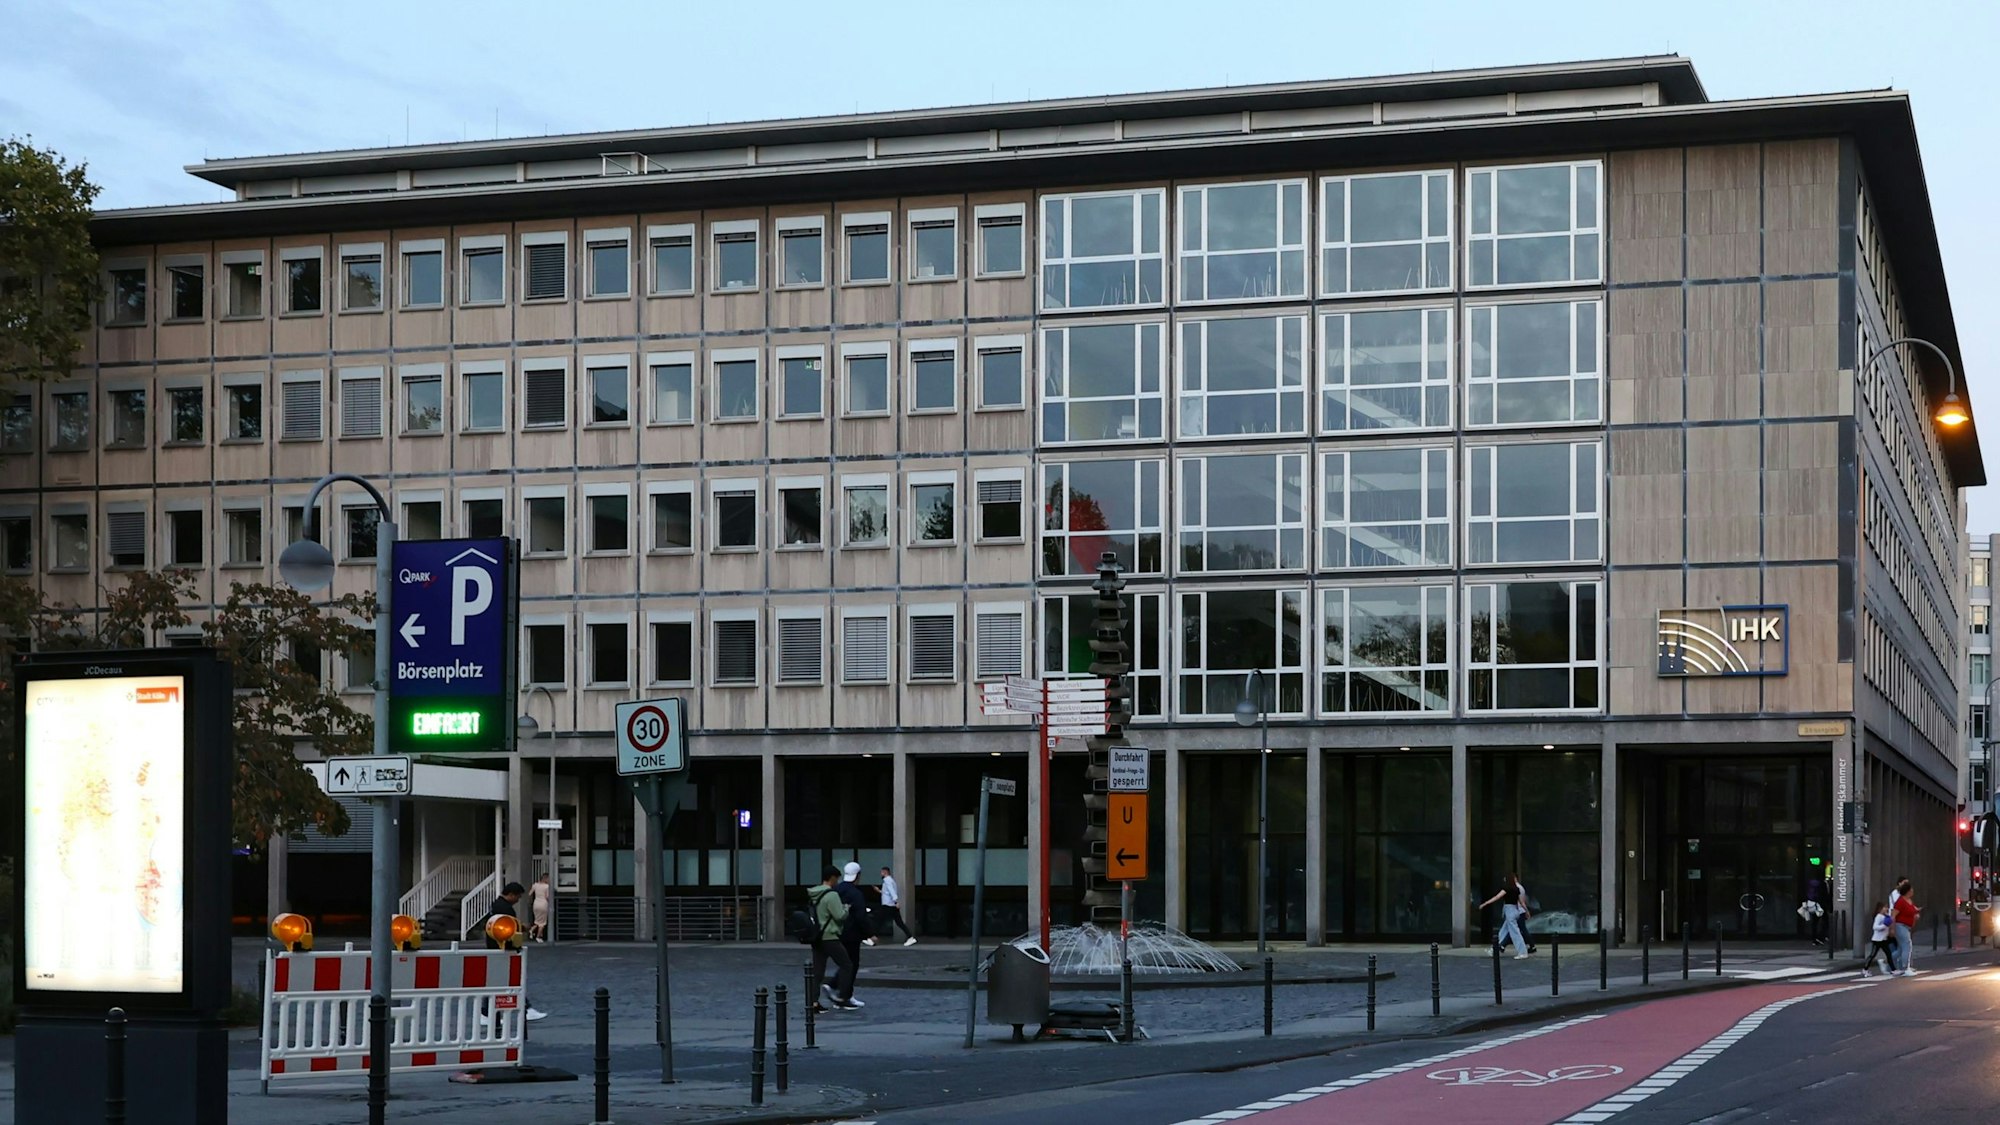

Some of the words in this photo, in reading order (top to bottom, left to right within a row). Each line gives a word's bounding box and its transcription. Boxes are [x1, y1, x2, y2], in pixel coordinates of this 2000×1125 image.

[451, 565, 493, 646] P
[1731, 617, 1780, 641] IHK
[84, 666, 123, 675] JCDecaux
[398, 658, 484, 684] Börsenplatz
[636, 717, 660, 740] 30
[634, 754, 666, 768] ZONE
[1114, 751, 1144, 762] Durchfahrt
[1112, 778, 1144, 787] gesperrt
[1123, 805, 1133, 824] U
[1837, 835, 1847, 853] und
[1837, 856, 1847, 902] Industrie-
